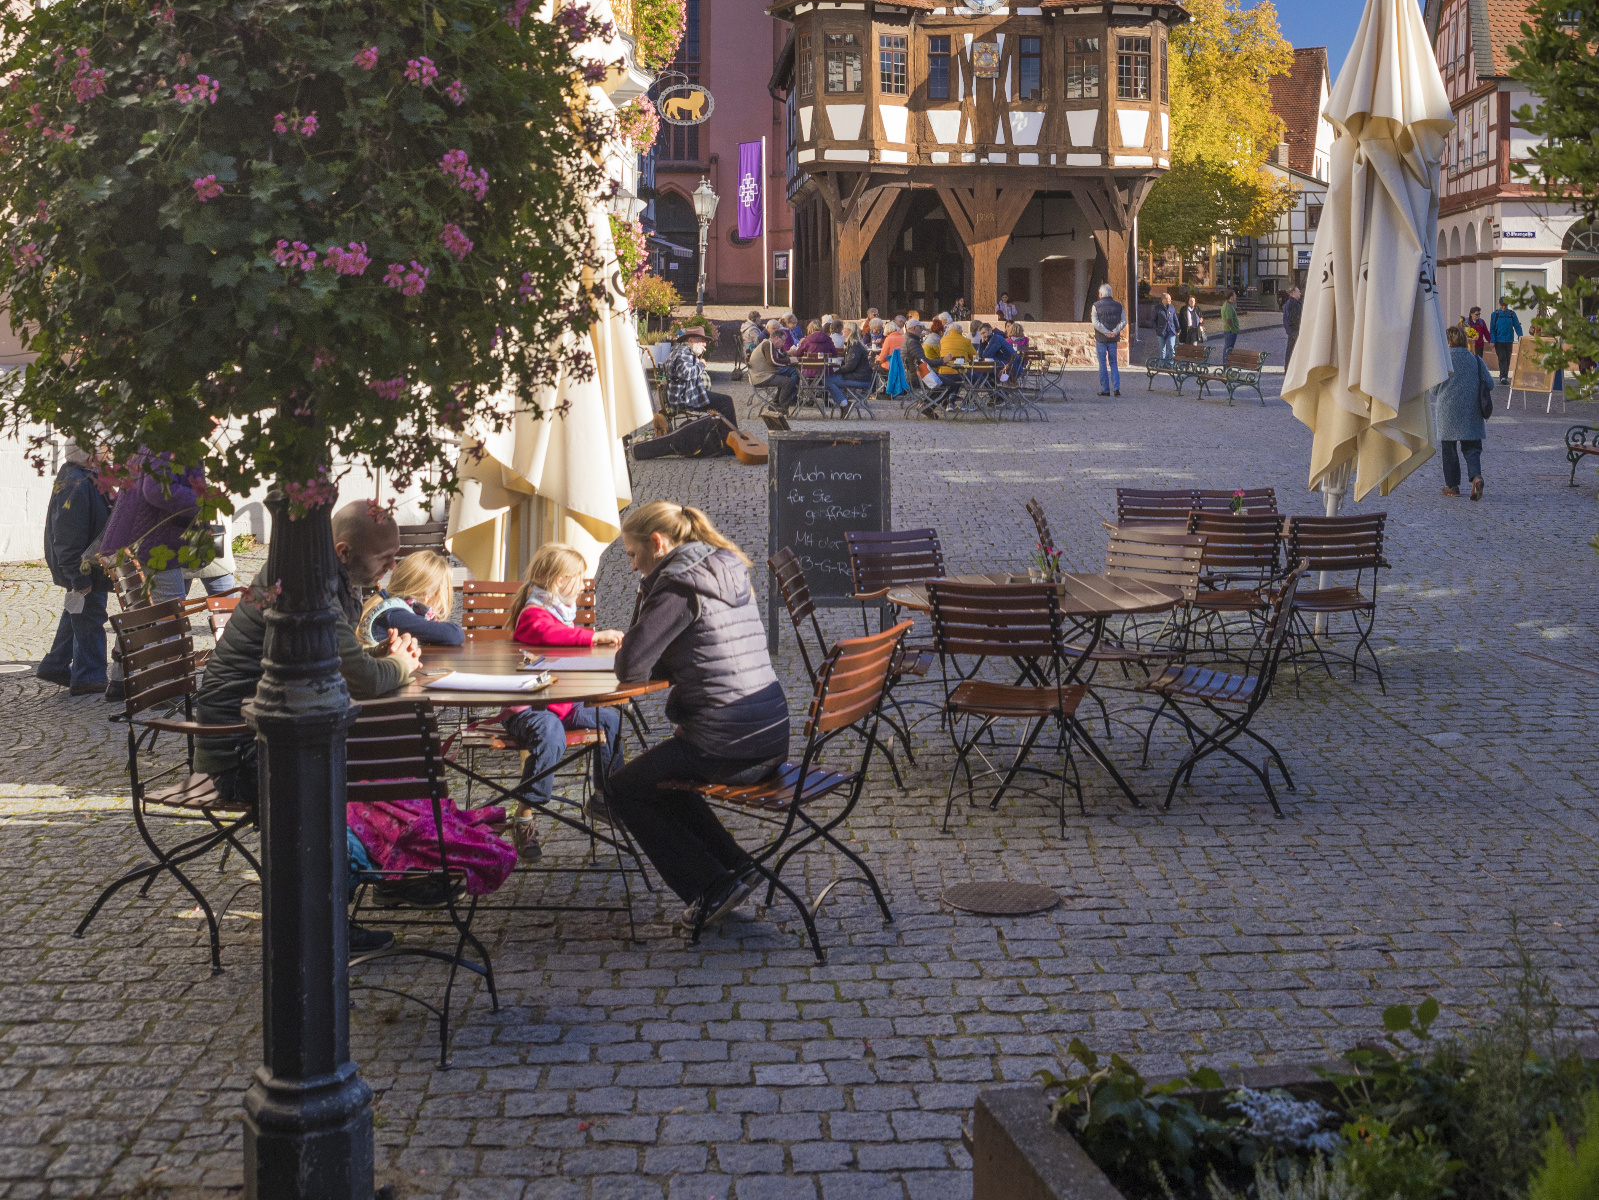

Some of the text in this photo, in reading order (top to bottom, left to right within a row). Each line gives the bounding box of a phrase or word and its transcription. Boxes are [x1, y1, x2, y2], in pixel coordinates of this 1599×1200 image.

[793, 461, 862, 482] Auch innen
[787, 488, 833, 505] für Sie
